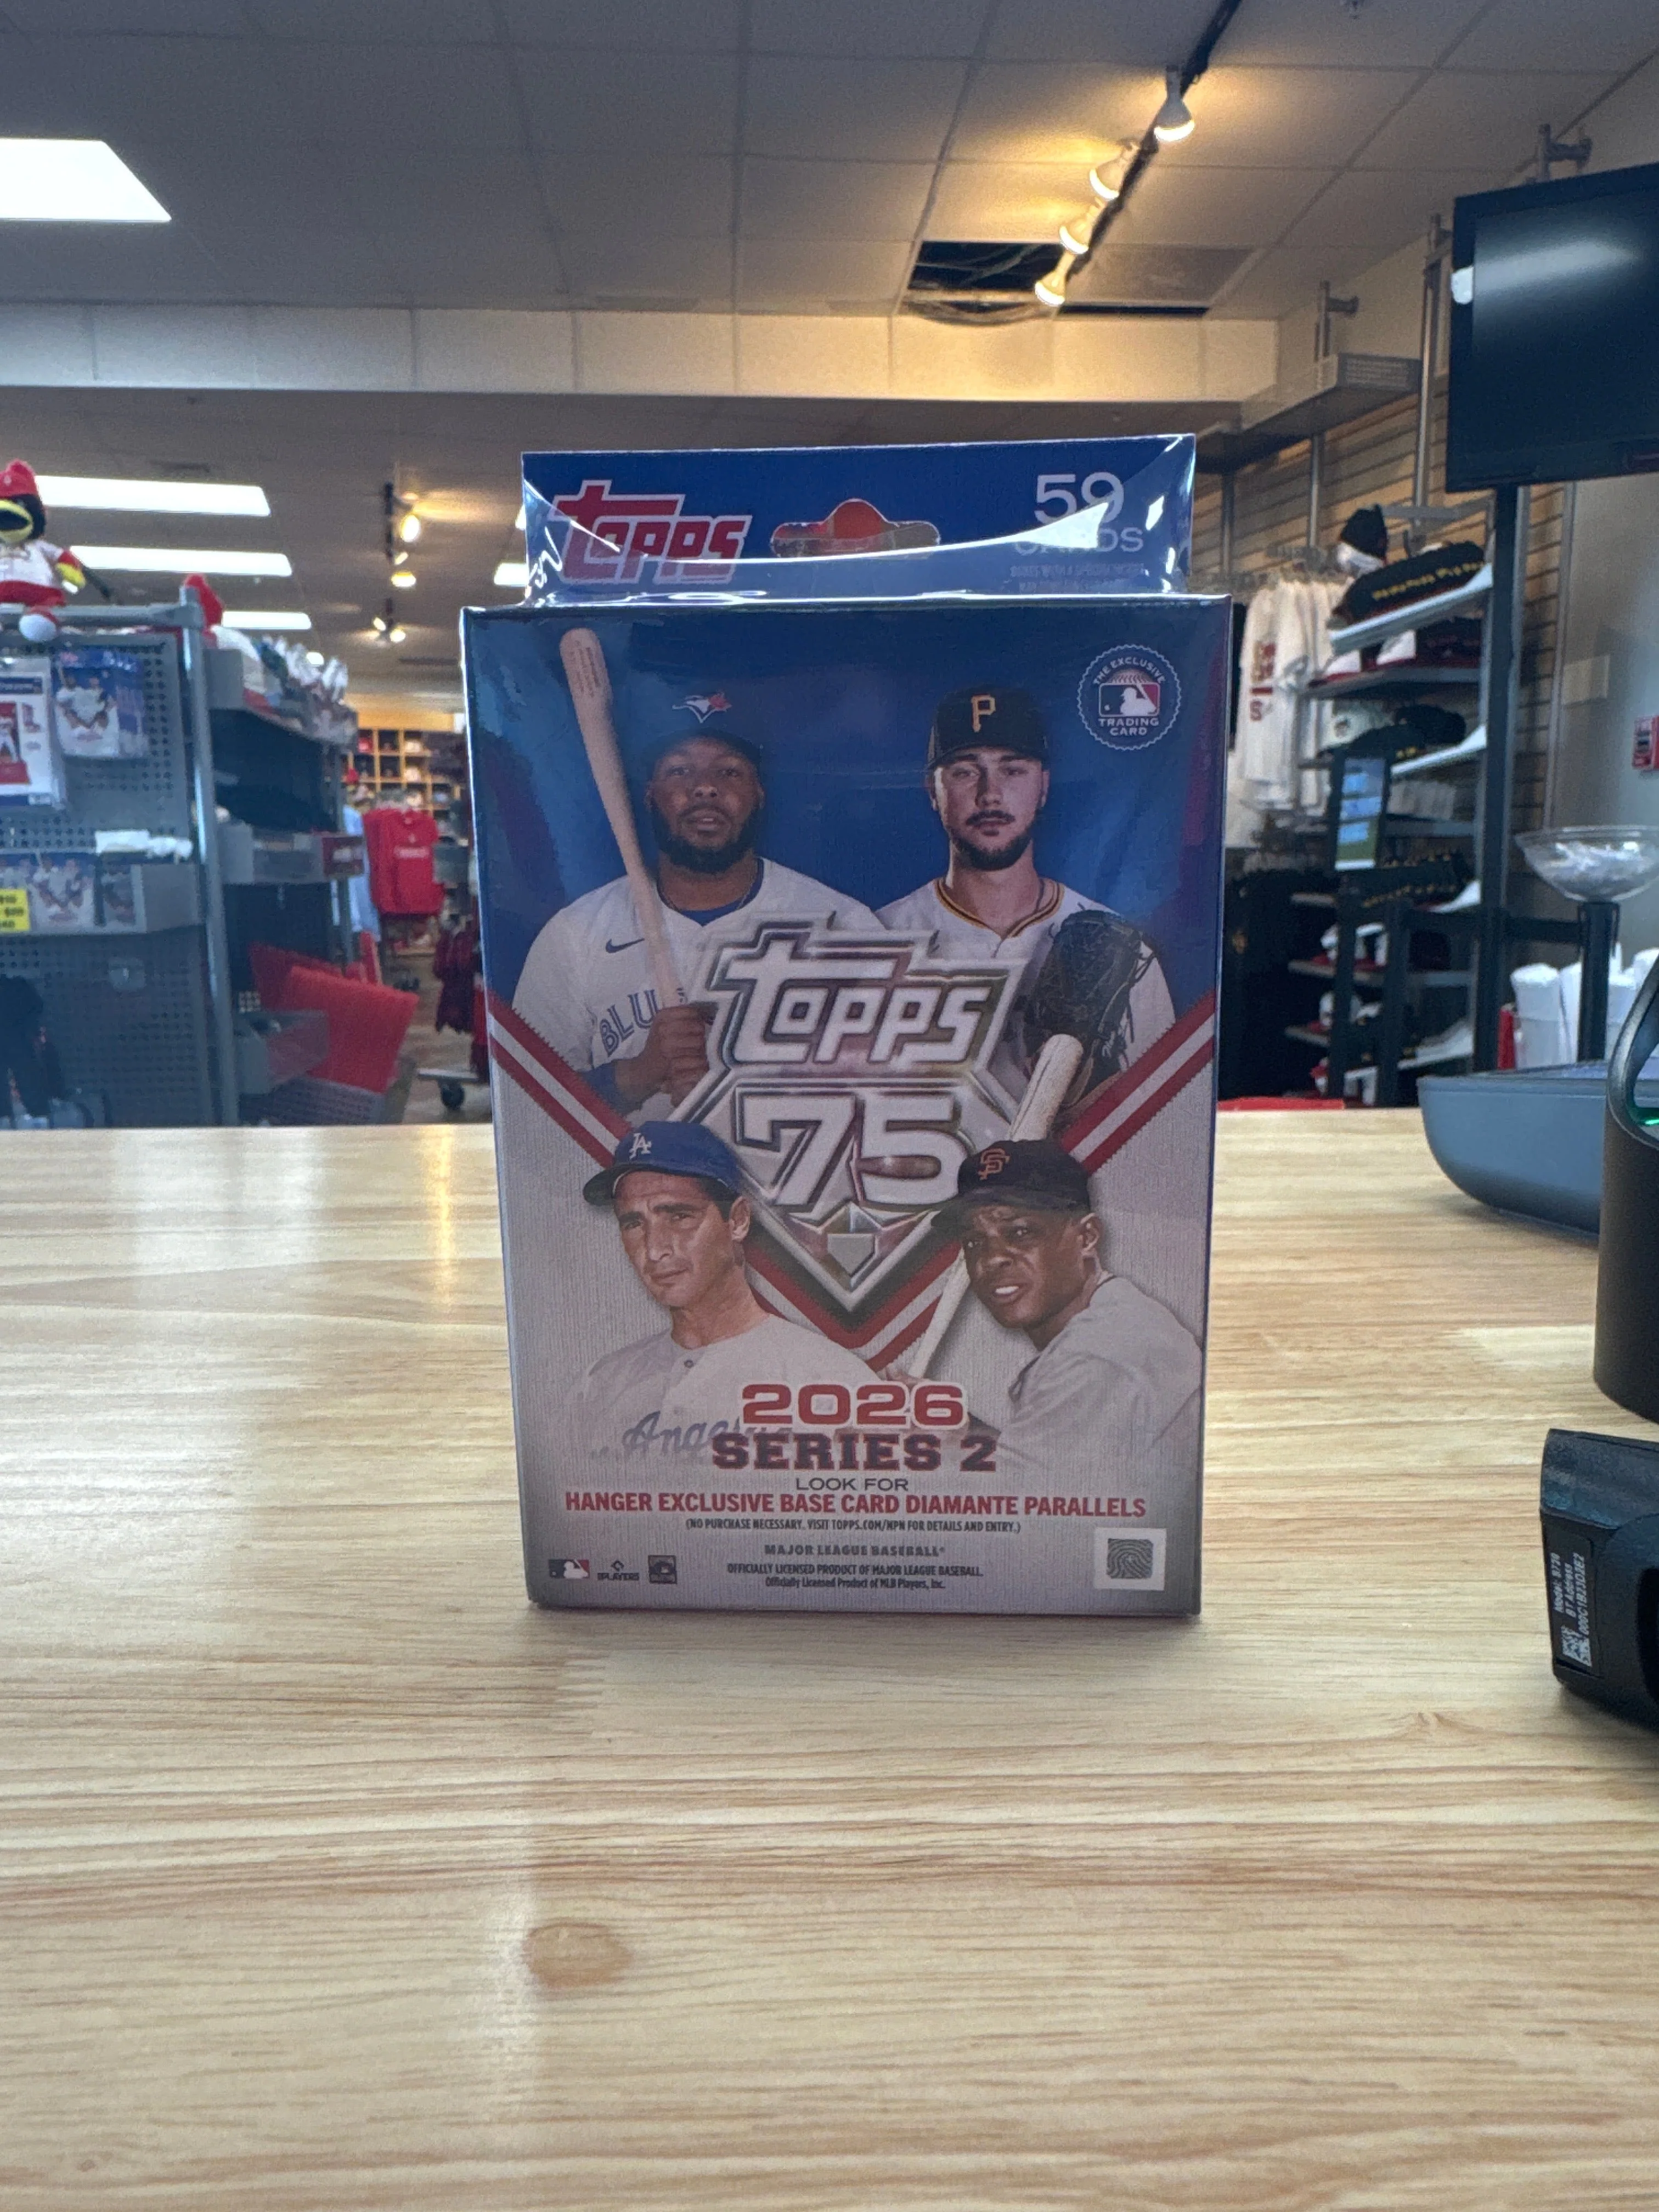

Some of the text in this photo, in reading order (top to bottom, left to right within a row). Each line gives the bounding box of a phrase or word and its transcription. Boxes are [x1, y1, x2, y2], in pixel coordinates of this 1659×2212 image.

[1034, 472, 1124, 527] 59
[1093, 656, 1166, 685] THE EXCLUSIVE
[971, 694, 996, 733] P
[1098, 718, 1159, 727] TRADING
[1109, 727, 1147, 736] CARD
[600, 988, 684, 1057] BLU
[740, 1094, 969, 1207] 75
[741, 1383, 964, 1426] 2026
[713, 1432, 997, 1472] SERIES 2
[797, 1477, 909, 1492] LOOK FOR
[566, 1492, 1146, 1517] HANGER EXCLUSIVE BASE CARD DIAMANTE PARALLELS
[686, 1518, 703, 1530] (NO
[705, 1519, 751, 1530] PURCHASE
[753, 1519, 806, 1530] NECESSARY.
[808, 1519, 828, 1530] VISIT
[907, 1520, 924, 1531] FOR
[927, 1520, 962, 1532] DETAILS
[964, 1521, 983, 1532] AND
[986, 1521, 1022, 1534] ENTRY.)
[765, 1544, 813, 1555] MAJOR
[817, 1545, 867, 1556] LEAGUE
[727, 1564, 984, 1577] OFFICIALLY LICENSED PRODUCT OF MAJOR LEAGUE BASEBALL.
[870, 1578, 878, 1589] of
[880, 1578, 896, 1589] MLB
